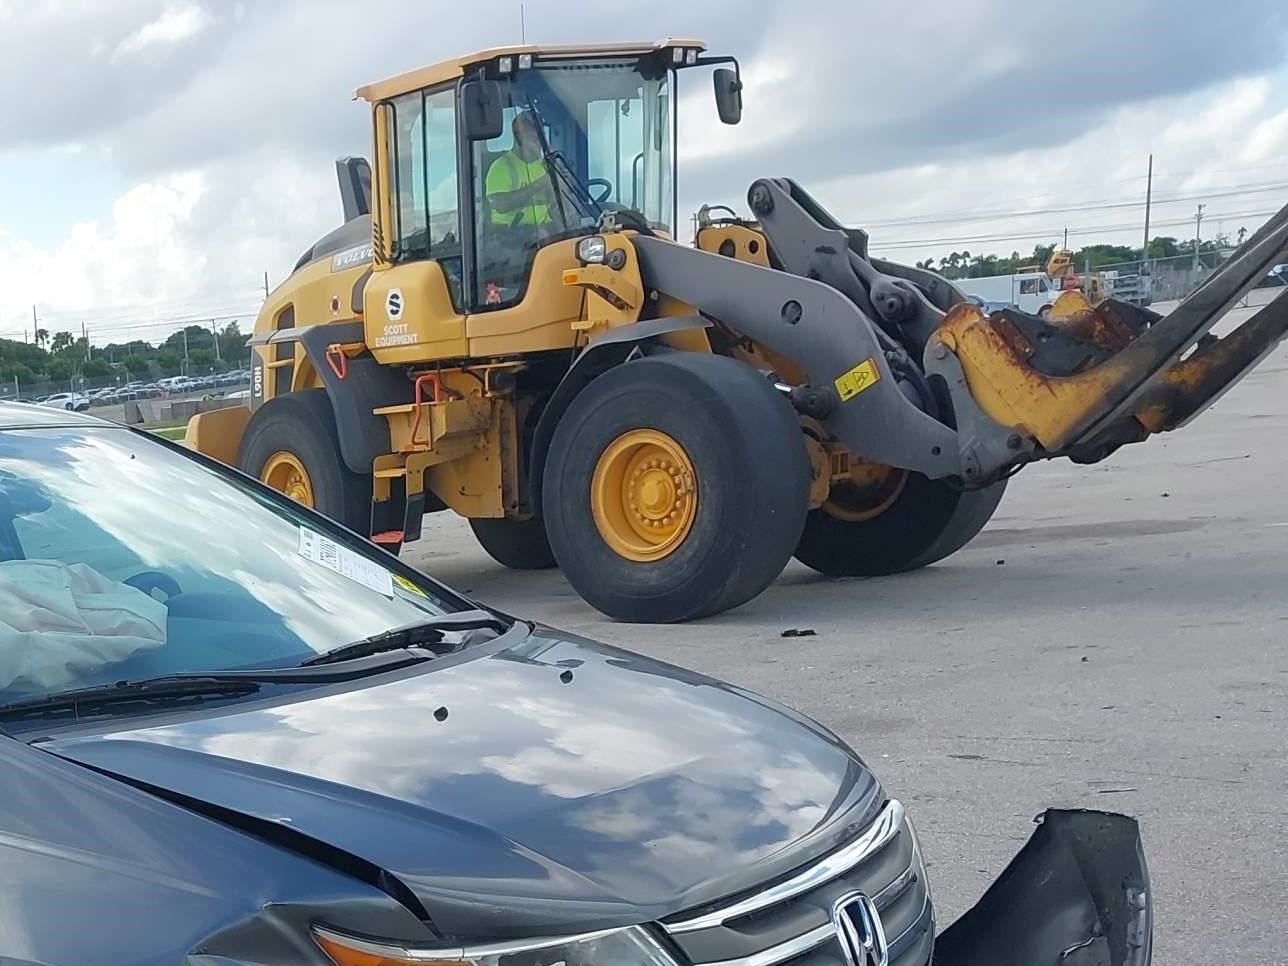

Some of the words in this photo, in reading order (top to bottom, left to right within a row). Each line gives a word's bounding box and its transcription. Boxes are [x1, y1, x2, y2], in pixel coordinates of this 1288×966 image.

[383, 324, 408, 336] SCOTT
[375, 333, 418, 348] EQUIPMENT
[254, 366, 262, 398] L90H
